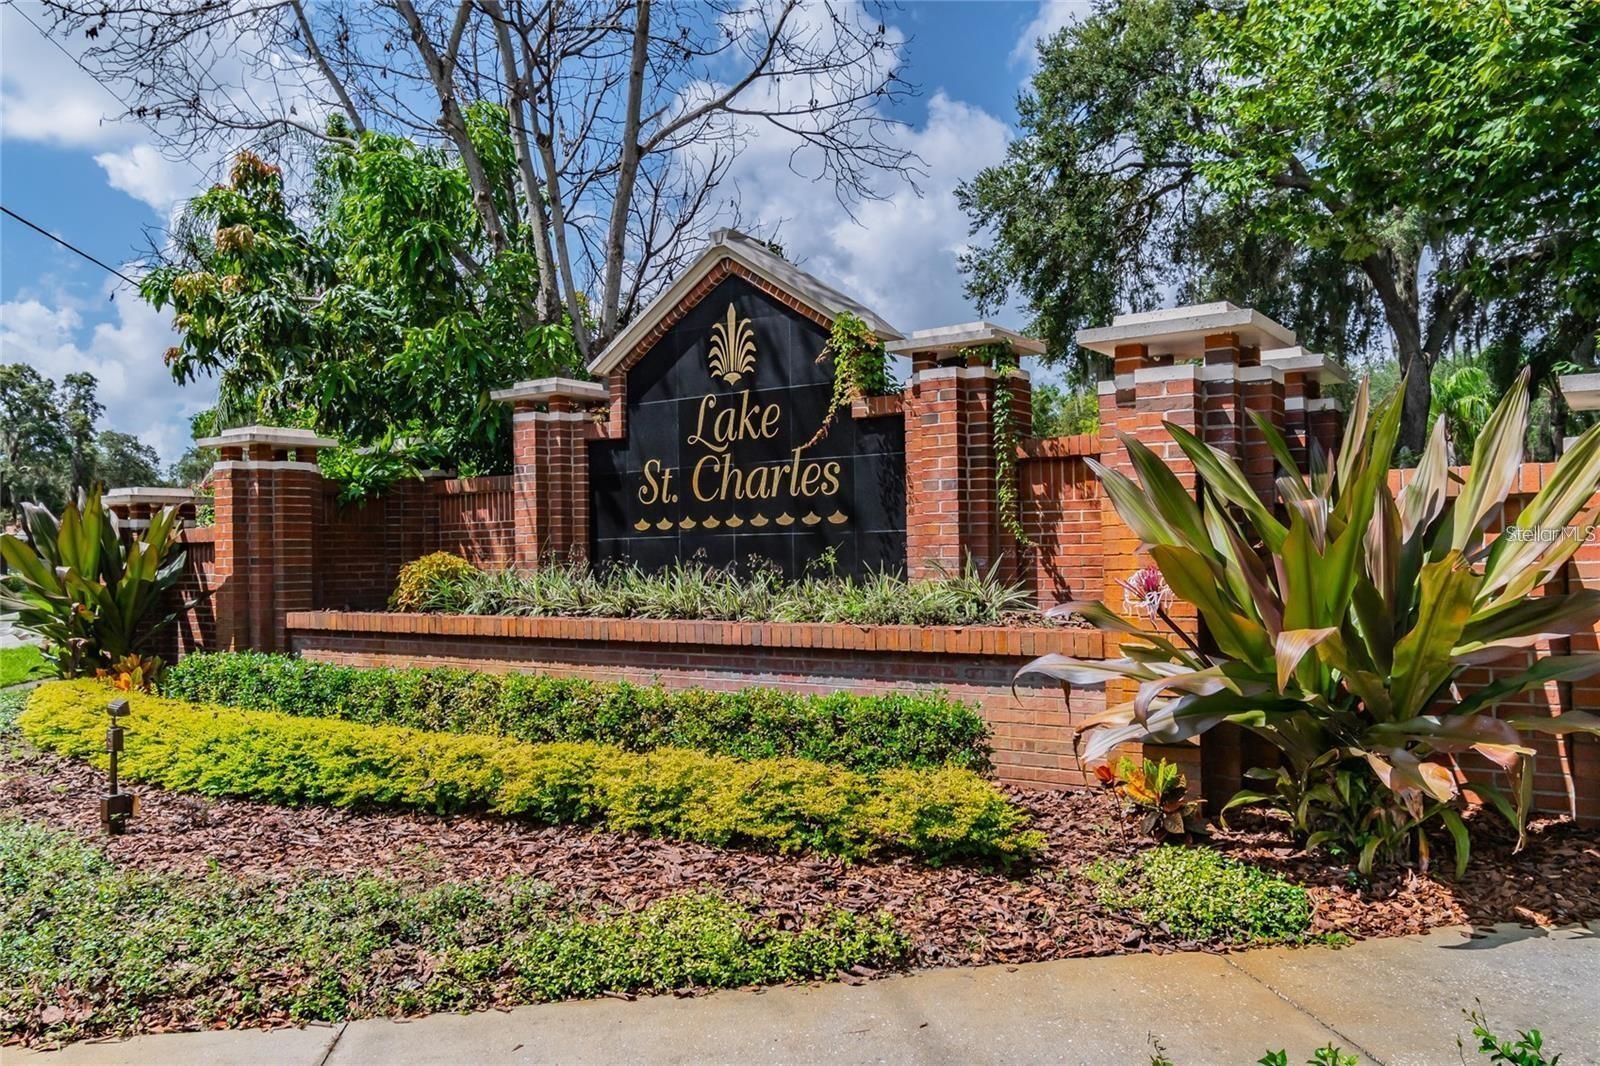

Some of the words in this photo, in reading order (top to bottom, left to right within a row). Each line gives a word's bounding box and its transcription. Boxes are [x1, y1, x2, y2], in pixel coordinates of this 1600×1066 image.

[687, 389, 780, 452] Lake
[638, 459, 678, 504] St.
[692, 448, 840, 502] Charles
